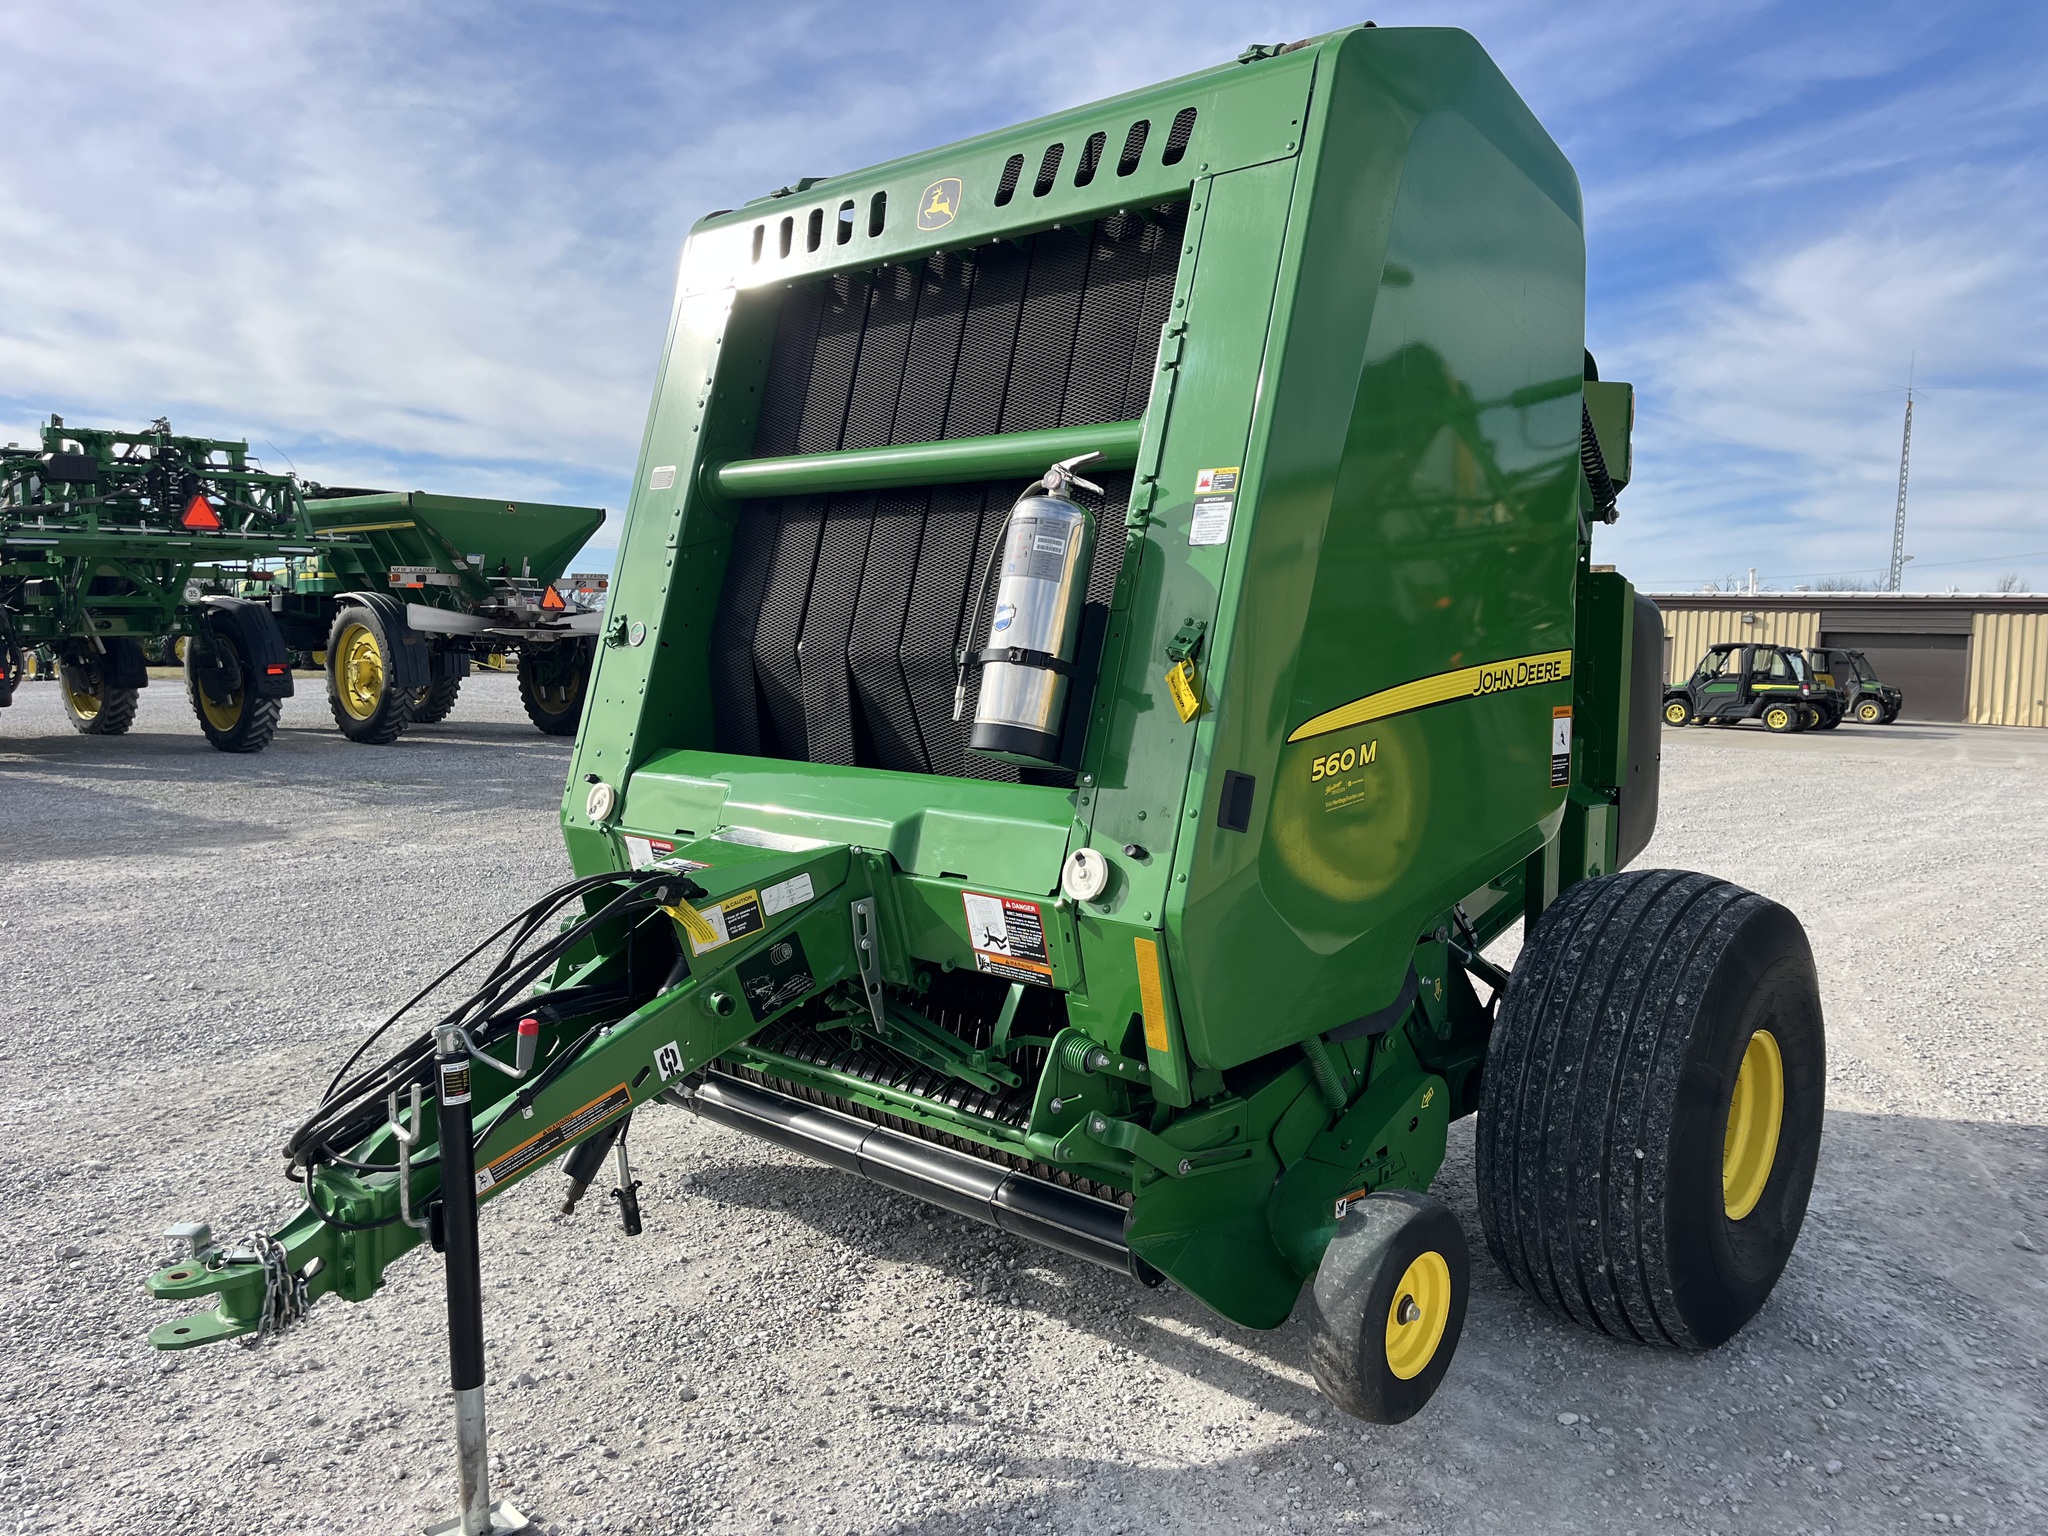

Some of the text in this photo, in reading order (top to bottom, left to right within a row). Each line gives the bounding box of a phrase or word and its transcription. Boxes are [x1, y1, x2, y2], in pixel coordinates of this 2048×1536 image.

[188, 590, 198, 598] 35
[1473, 660, 1562, 693] JOHN DEERE
[1311, 738, 1378, 782] 560 M
[730, 895, 753, 908] CAUTION
[1012, 902, 1036, 912] DANGER
[1010, 960, 1034, 970] WARNING
[546, 1114, 574, 1132] WARNING
